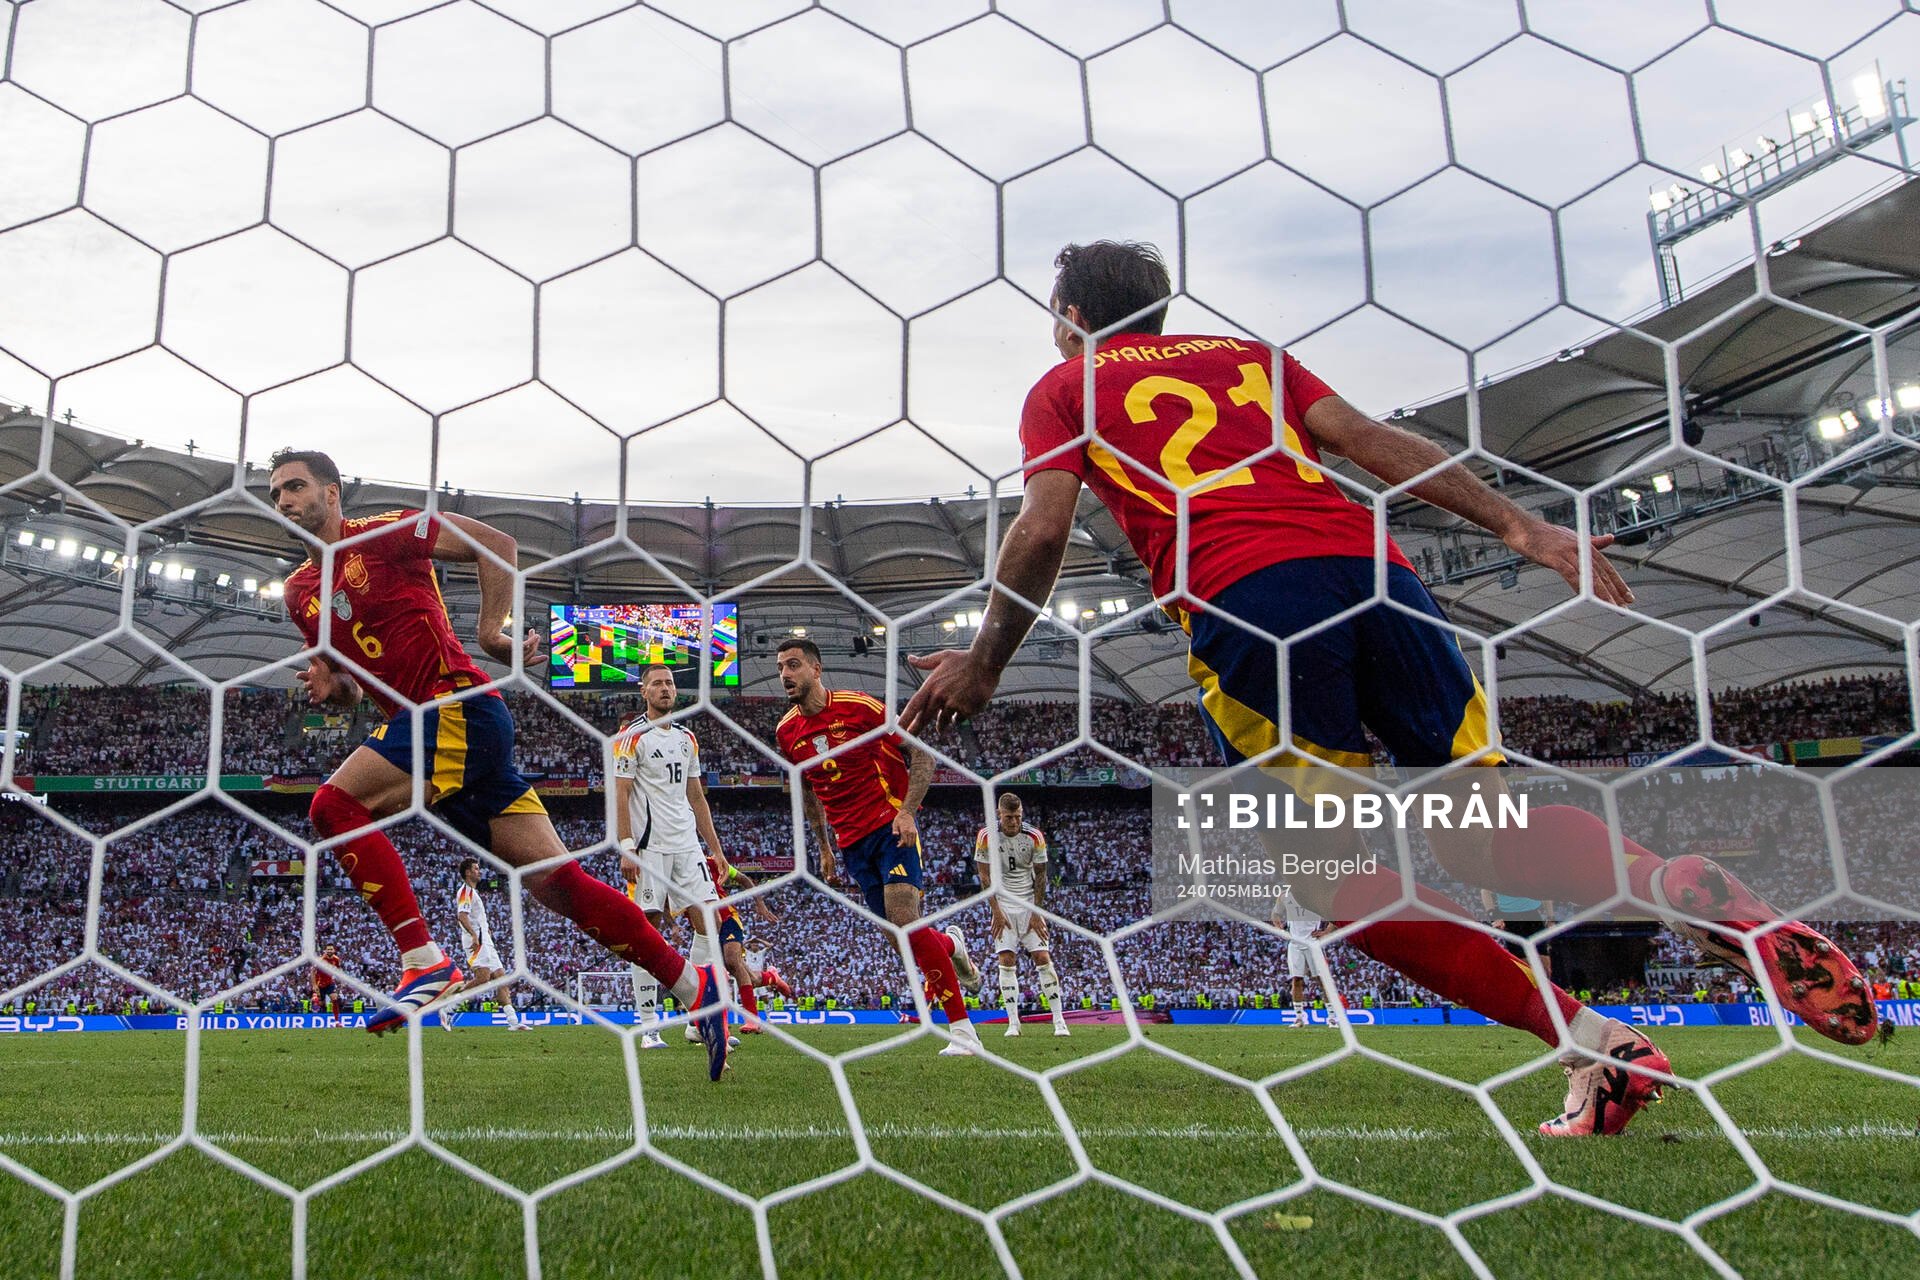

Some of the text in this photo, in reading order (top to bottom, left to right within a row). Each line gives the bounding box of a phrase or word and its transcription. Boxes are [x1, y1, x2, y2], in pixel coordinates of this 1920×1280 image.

[1124, 362, 1324, 498] 21
[352, 621, 382, 658] 6
[665, 762, 682, 784] 16
[822, 759, 842, 782] 9
[93, 777, 204, 790] STUTTGART
[246, 1016, 305, 1030] YOUR
[311, 1016, 374, 1030] DREA
[1630, 1005, 1684, 1026] BYD
